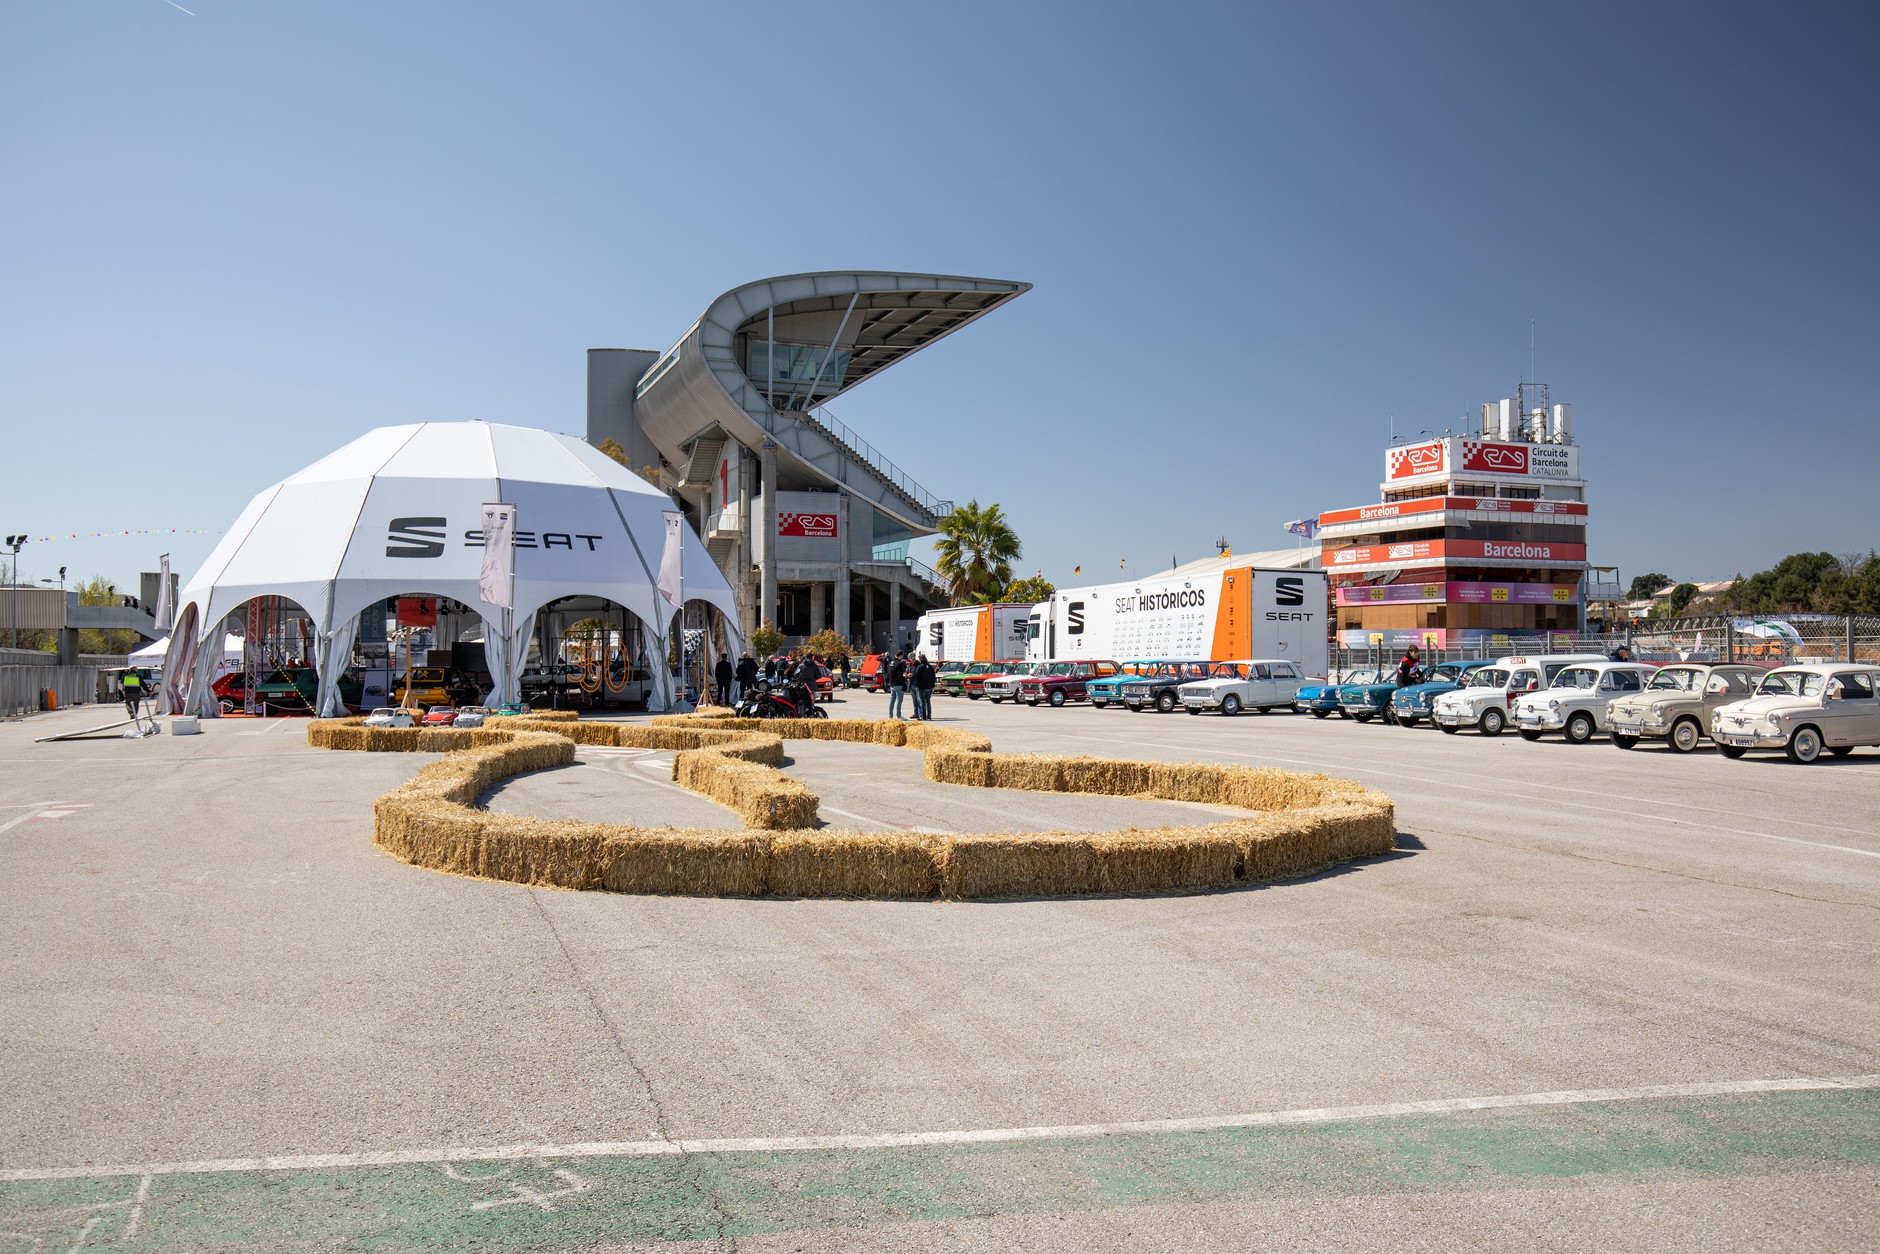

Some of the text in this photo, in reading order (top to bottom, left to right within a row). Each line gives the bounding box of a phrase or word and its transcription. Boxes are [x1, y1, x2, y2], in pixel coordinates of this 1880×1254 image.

[1532, 447, 1569, 457] Circuit de
[1532, 458, 1568, 467] Barcelona
[1413, 464, 1438, 474] Barcelona
[1532, 467, 1569, 476] CATALUNYA
[1360, 505, 1399, 519] Barcelona
[1484, 542, 1550, 558] Barcelona
[1115, 588, 1205, 614] SEAT HISTÓRICOS
[1265, 612, 1313, 621] SEAT
